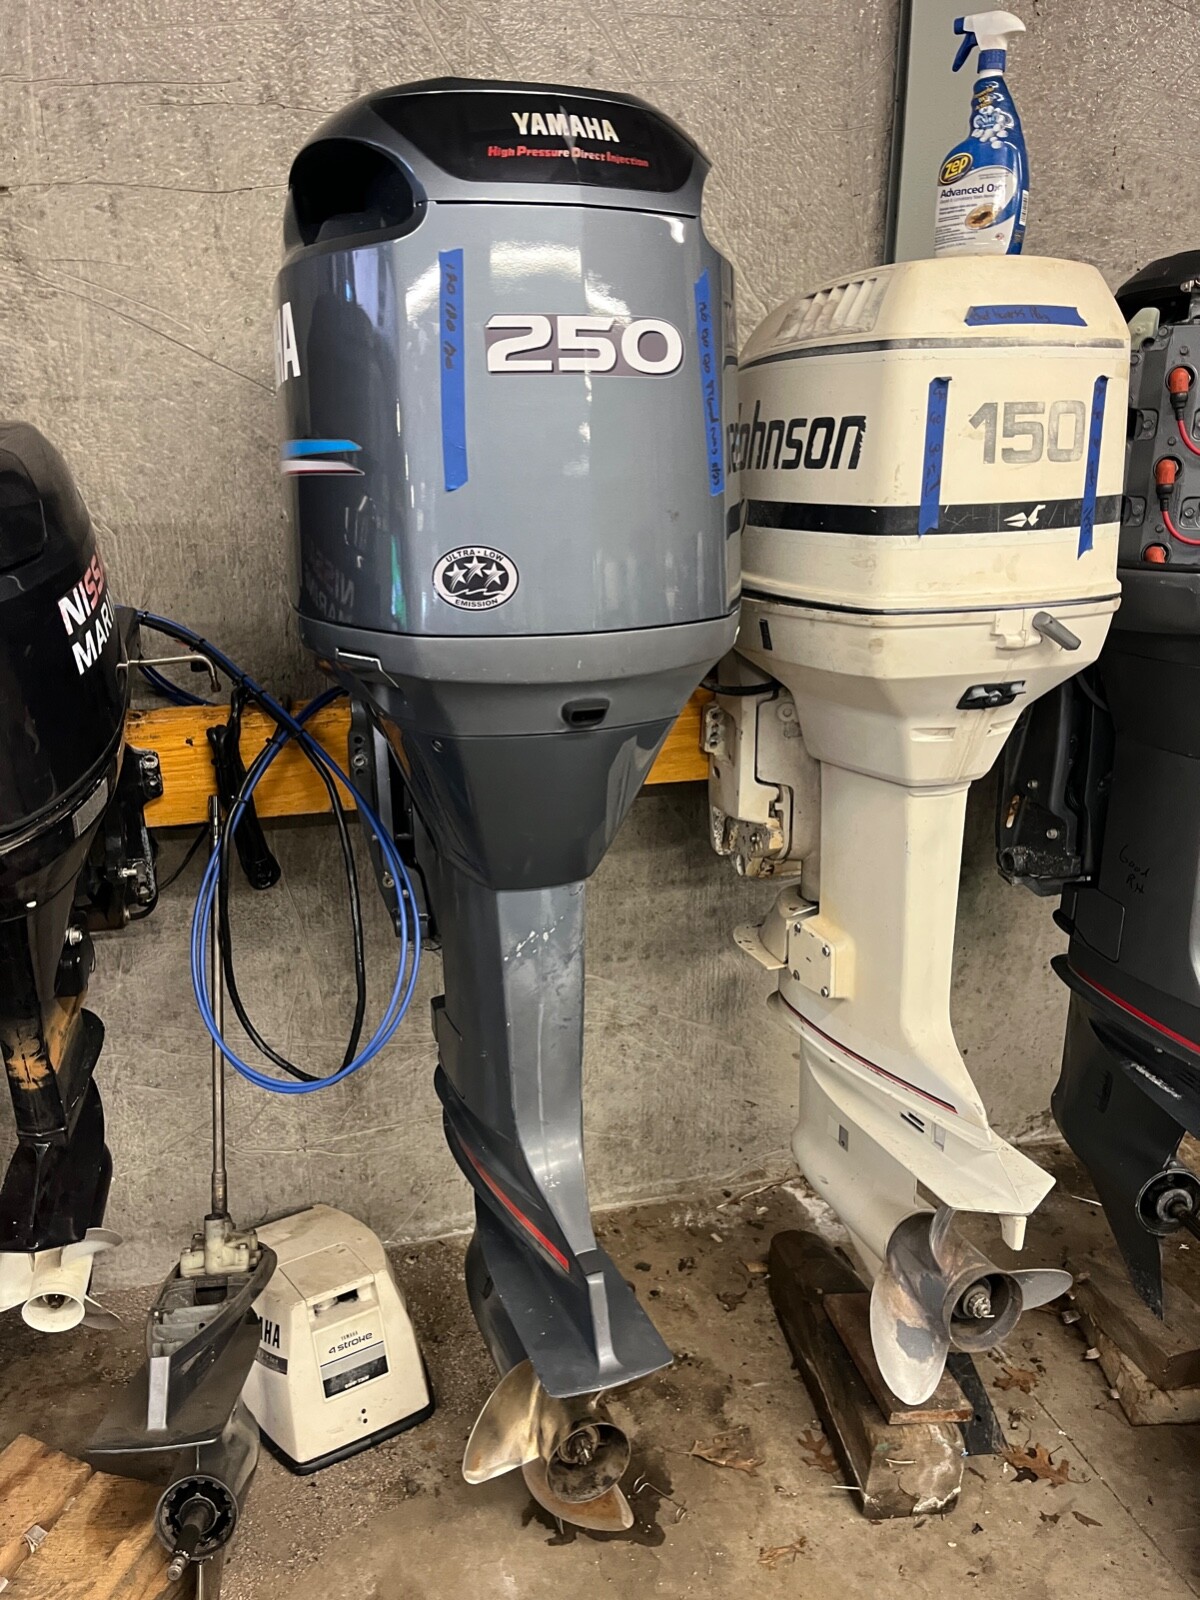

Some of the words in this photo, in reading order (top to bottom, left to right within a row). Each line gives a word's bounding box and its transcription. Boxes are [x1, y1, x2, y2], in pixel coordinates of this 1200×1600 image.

[511, 112, 620, 143] YAMAHA
[487, 145, 515, 158] High
[516, 145, 570, 158] Pressure
[571, 146, 605, 162] Direct
[606, 151, 649, 168] Injection
[940, 184, 984, 198] Advanced
[486, 315, 683, 374] 250
[968, 400, 1086, 464] 150
[445, 549, 476, 563] ULTRA
[483, 550, 504, 562] LOW
[58, 554, 104, 636] NISS
[455, 598, 498, 608] EMISSION
[328, 1346, 337, 1354] 4
[337, 1332, 373, 1352] stroke
